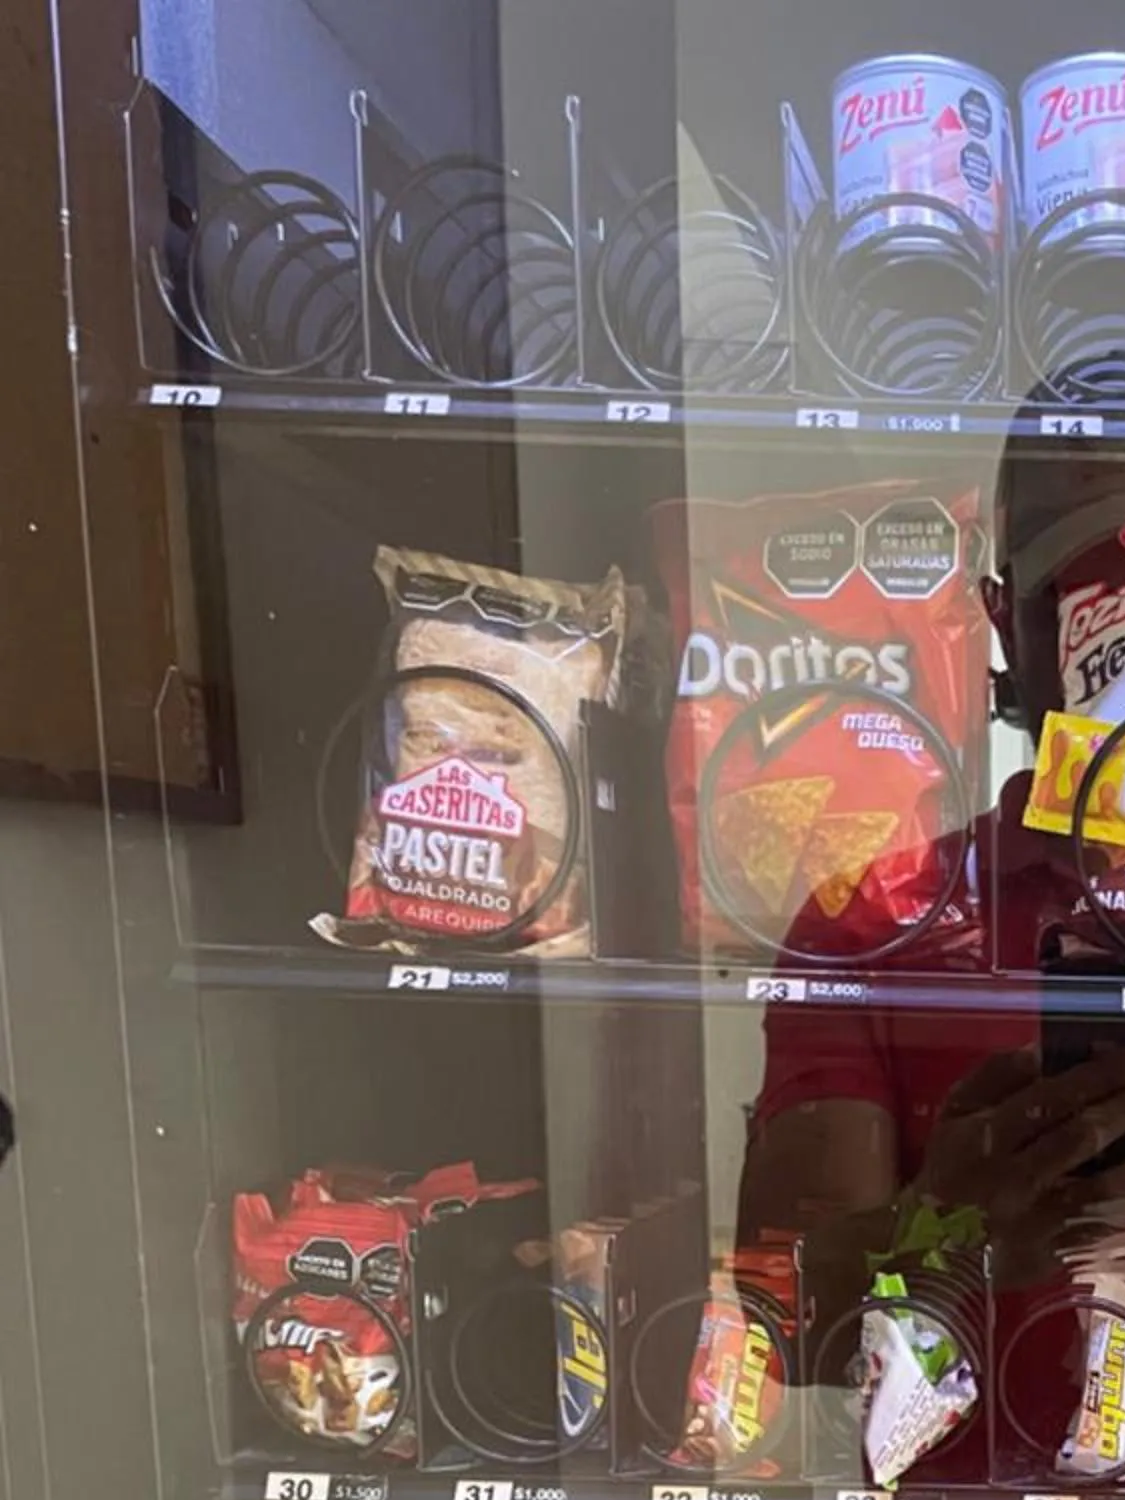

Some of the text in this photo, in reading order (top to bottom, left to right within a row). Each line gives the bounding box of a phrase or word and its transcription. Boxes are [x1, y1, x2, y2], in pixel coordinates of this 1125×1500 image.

[840, 76, 925, 153] Zenú
[616, 406, 650, 422] 12
[1050, 419, 1084, 435] 14
[679, 632, 910, 697] Doritos
[842, 713, 901, 731] MEGA
[858, 732, 924, 751] QUESO
[437, 765, 472, 785] LAS
[388, 785, 517, 829] CASERITAS
[383, 822, 508, 890] PASTEL
[384, 874, 511, 912] OJALDRADO
[401, 971, 433, 988] 21
[452, 971, 506, 986] $2,200
[756, 982, 790, 1000] 23
[280, 1479, 313, 1500] 30
